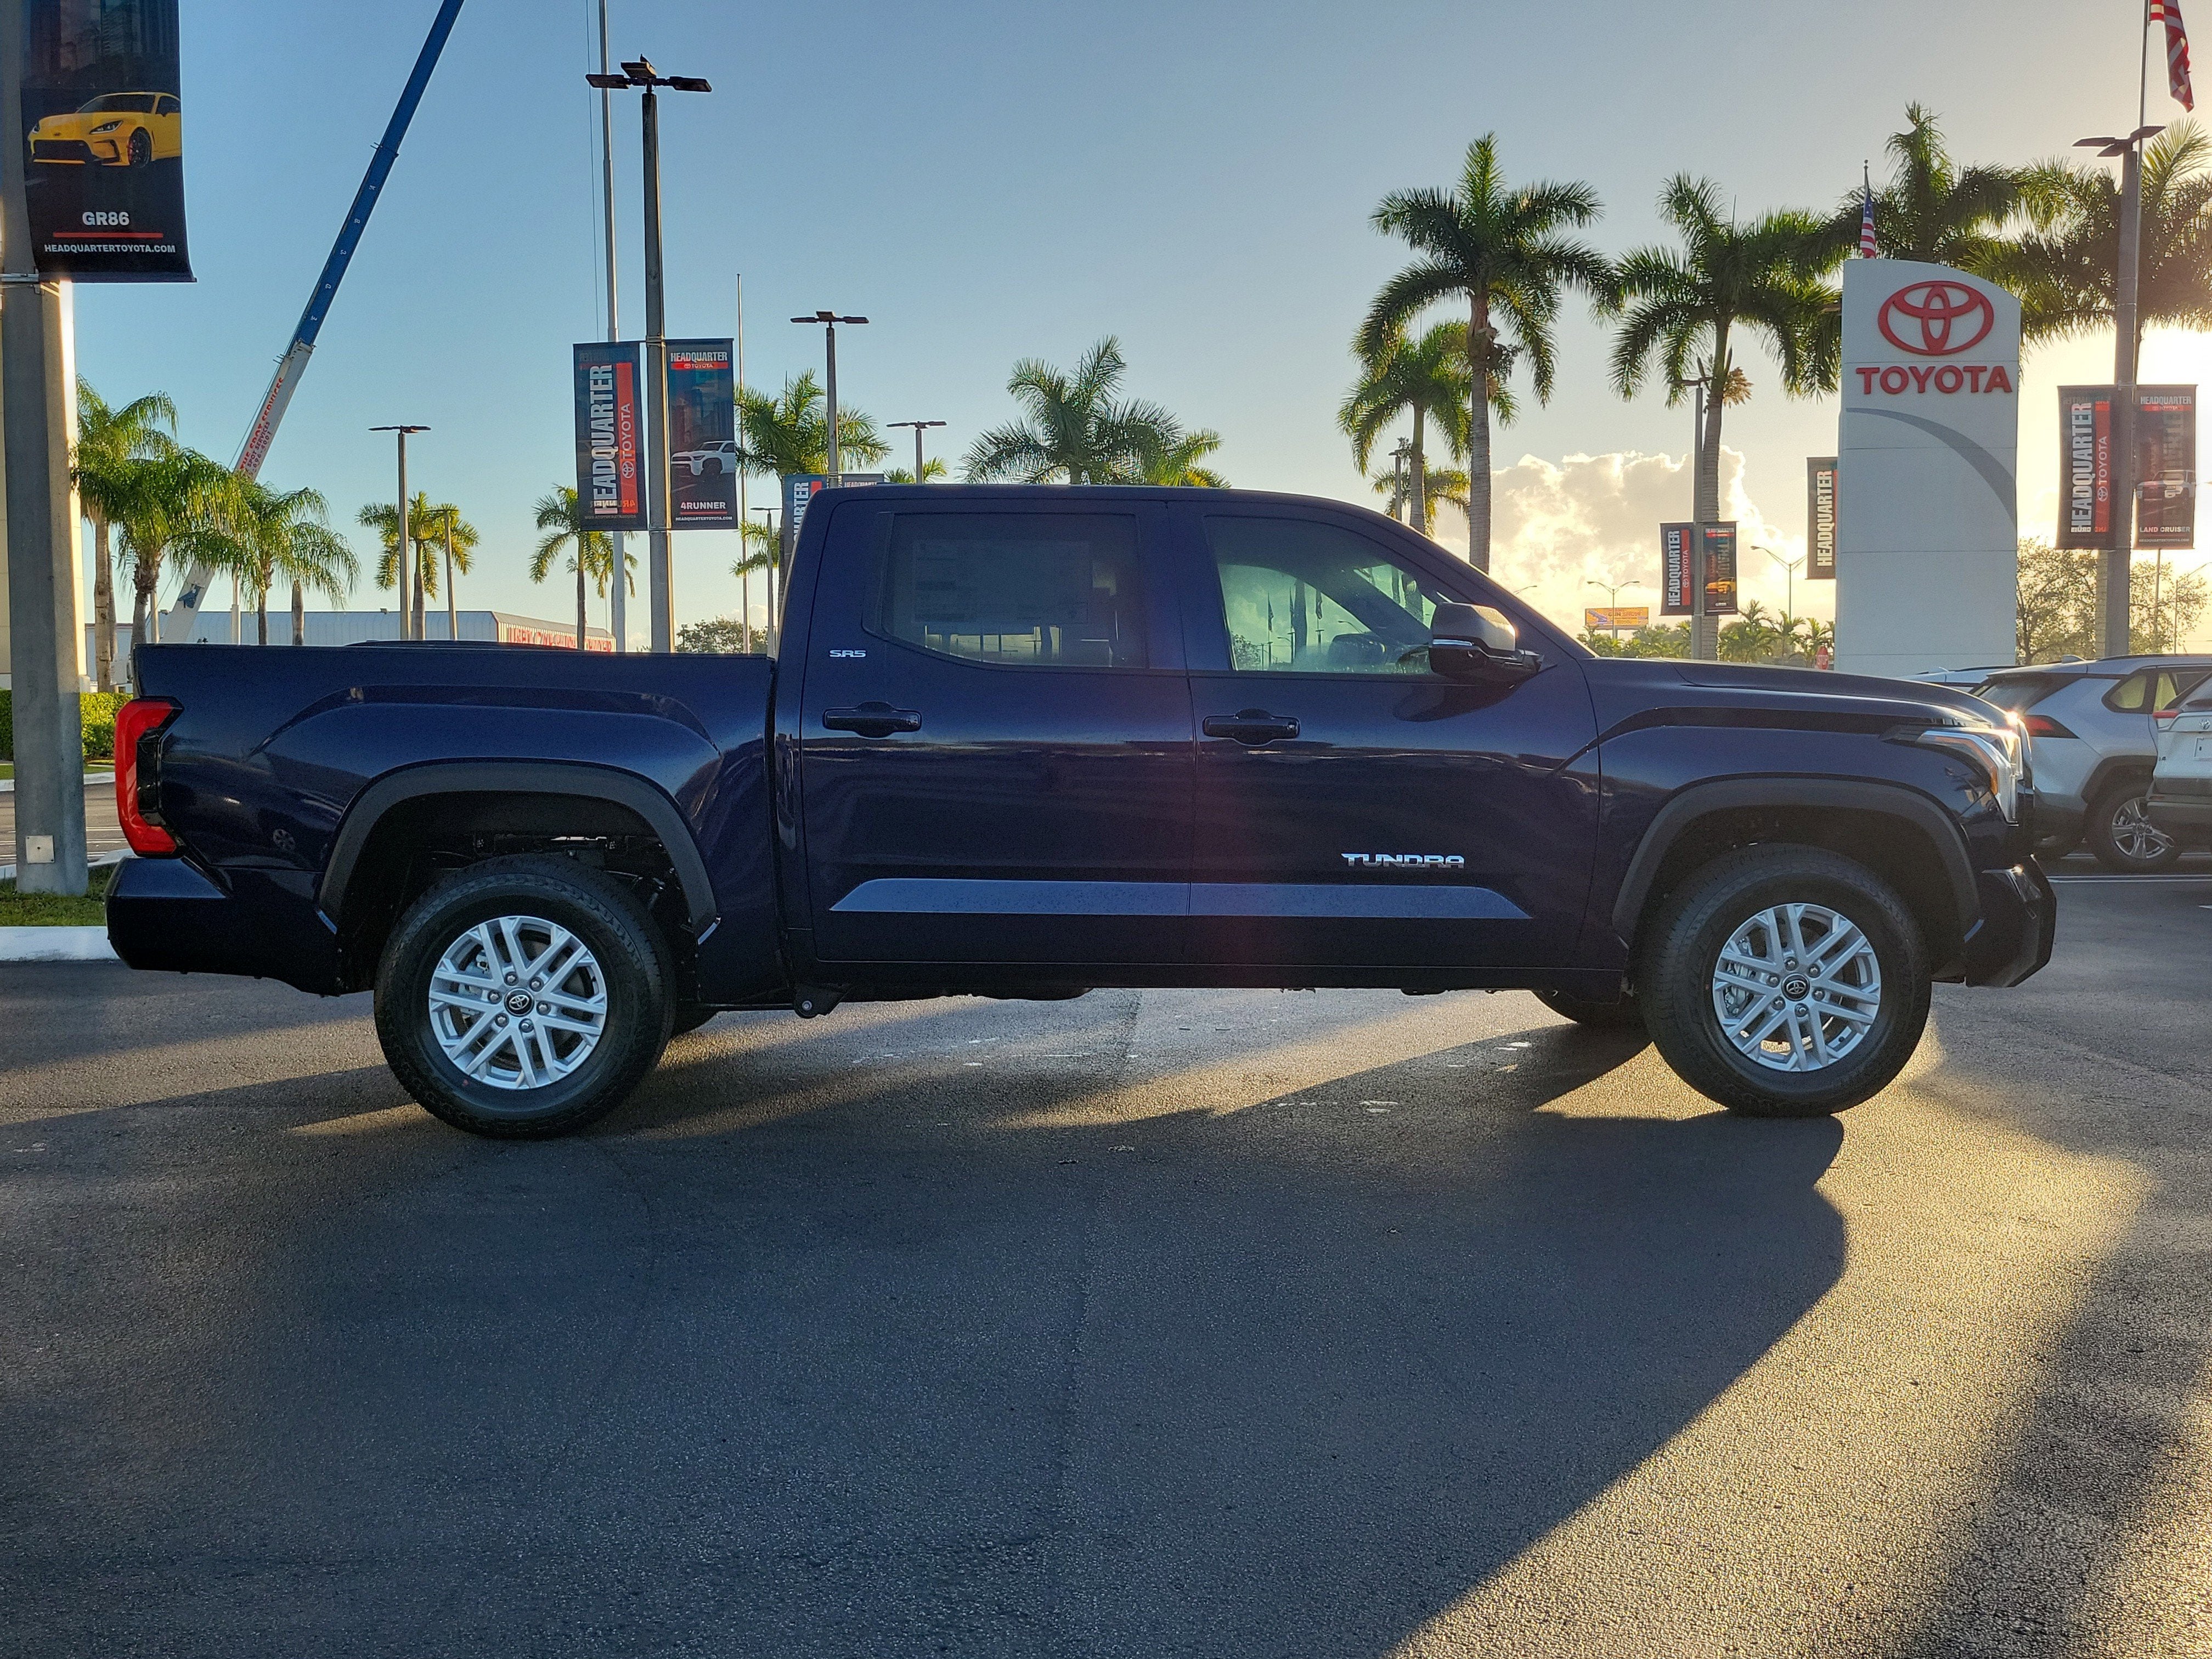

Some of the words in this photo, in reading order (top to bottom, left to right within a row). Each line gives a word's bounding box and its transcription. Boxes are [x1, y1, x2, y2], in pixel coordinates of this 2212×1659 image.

[82, 212, 129, 225] GR86
[44, 244, 176, 253] HEADQUARTERTOYOTA.COM
[670, 352, 728, 363] HEADQUARTER
[1855, 365, 2012, 395] TOYOTA
[2140, 396, 2192, 405] HEADQUARTER
[589, 364, 619, 515] HEADQUARTER
[622, 403, 631, 459] TOYOTA
[2070, 403, 2096, 533] HEADQUARTER
[2099, 436, 2107, 485] TOYOTA
[680, 501, 726, 510] 4RUNNER
[1816, 471, 1835, 566] HEADQUARTER
[1668, 530, 1681, 606] HEADQUARTER
[1341, 853, 1464, 868] TUNDRA
